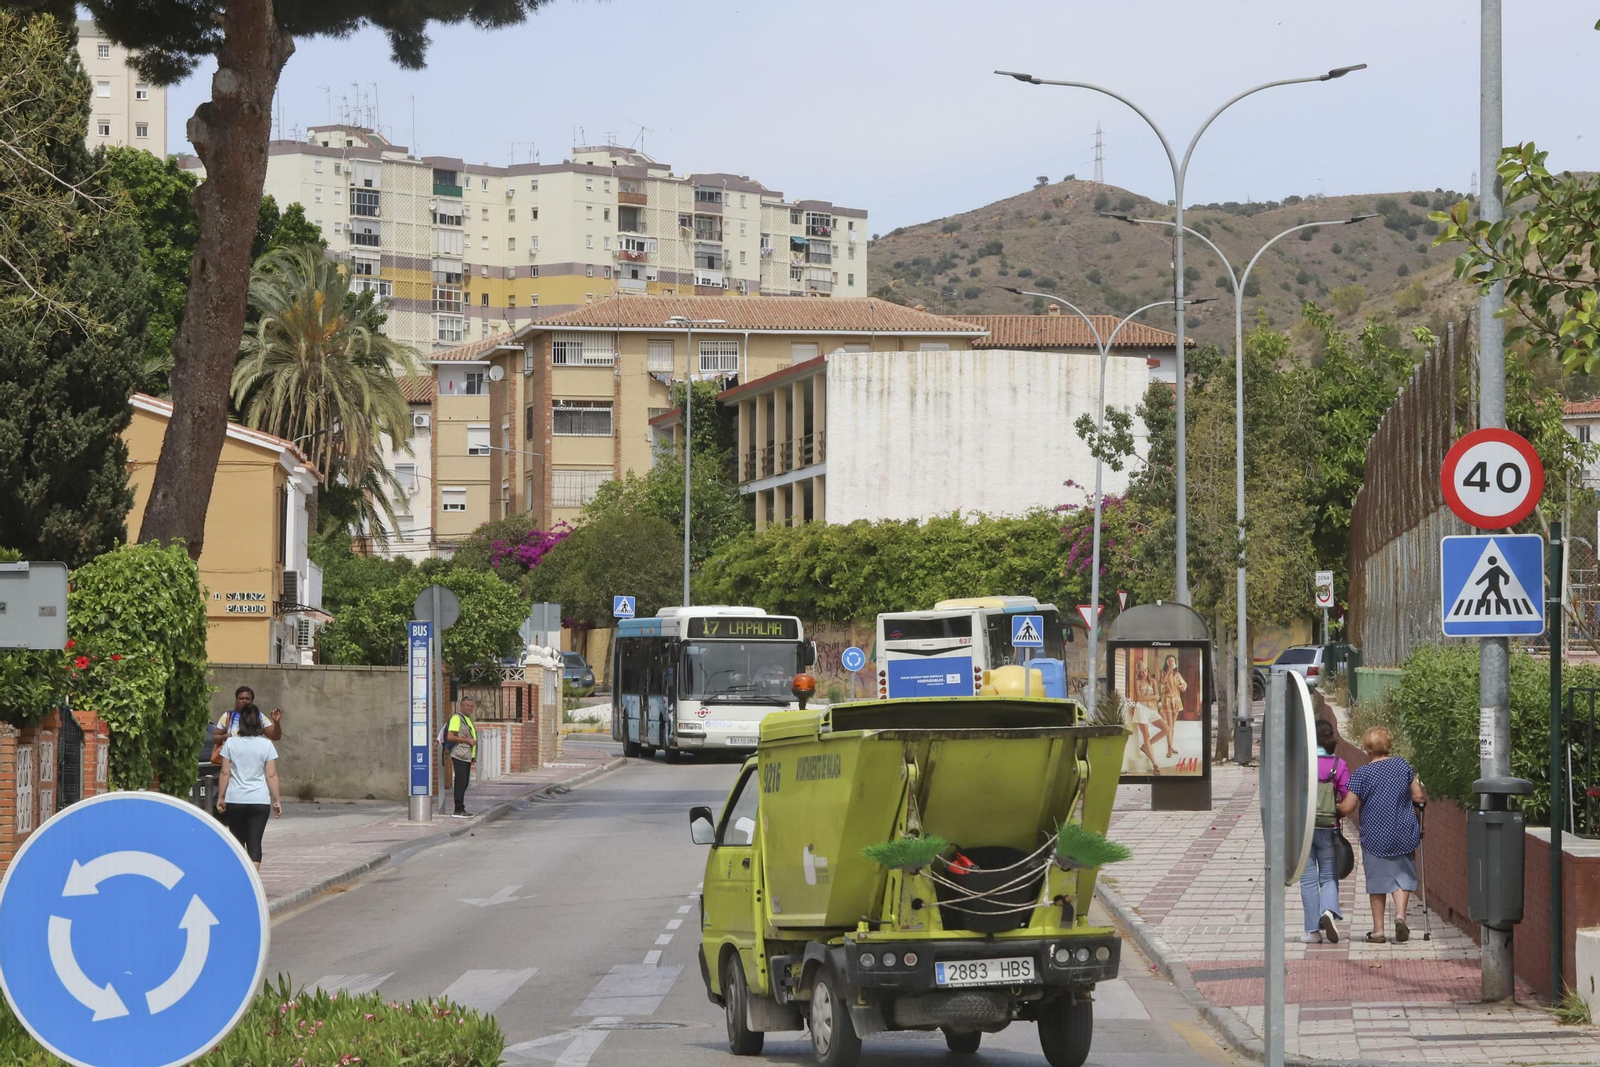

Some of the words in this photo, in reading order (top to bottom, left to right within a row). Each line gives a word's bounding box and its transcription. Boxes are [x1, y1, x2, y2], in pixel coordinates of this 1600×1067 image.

[1463, 462, 1521, 493] 40
[226, 592, 265, 601] SAINZ
[226, 604, 266, 613] PARDO
[412, 625, 427, 636] BUS
[702, 620, 719, 634] 17
[729, 621, 743, 634] LA
[746, 621, 782, 635] PALMA
[764, 762, 781, 793] 9216
[948, 963, 988, 981] 2883
[1001, 961, 1031, 978] HBS
